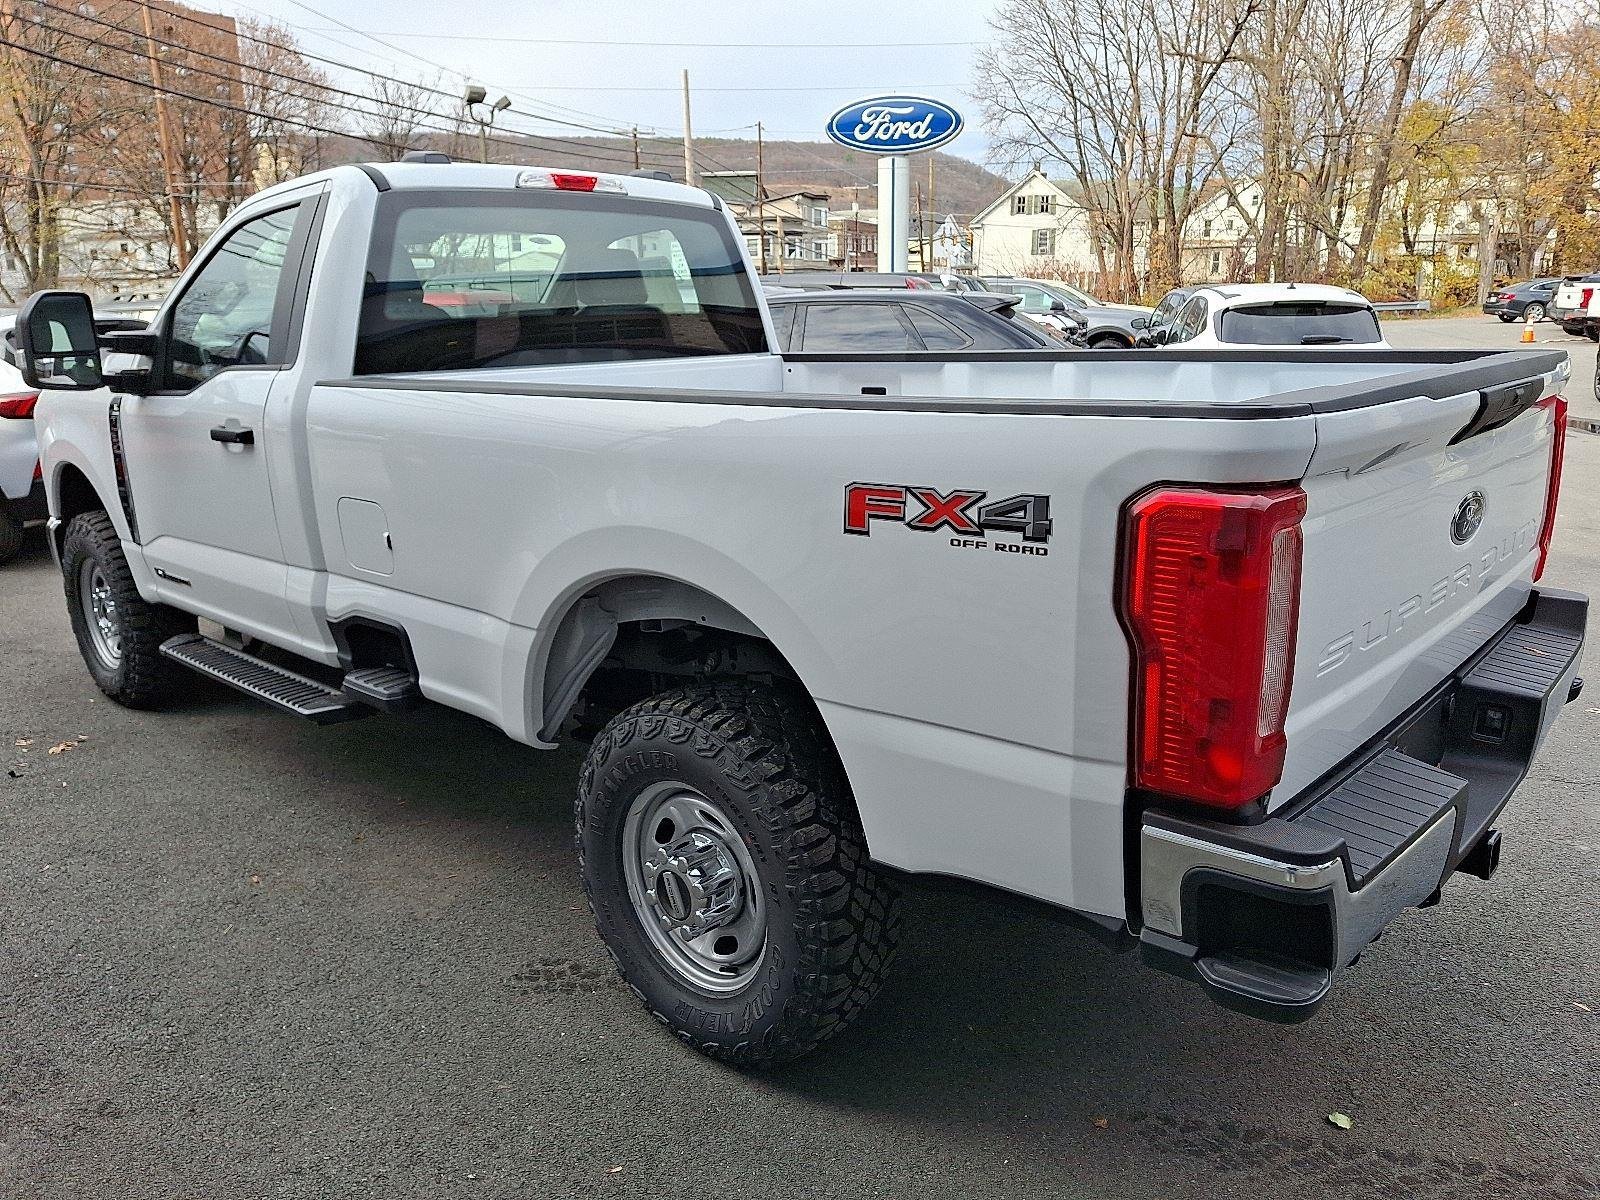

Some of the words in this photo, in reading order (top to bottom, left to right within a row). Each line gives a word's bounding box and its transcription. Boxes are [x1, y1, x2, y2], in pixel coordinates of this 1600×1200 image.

[853, 106, 935, 141] Ford
[843, 481, 1053, 544] FX4
[949, 538, 988, 549] OFF
[994, 542, 1049, 557] ROAD
[1316, 562, 1474, 678] SUPER
